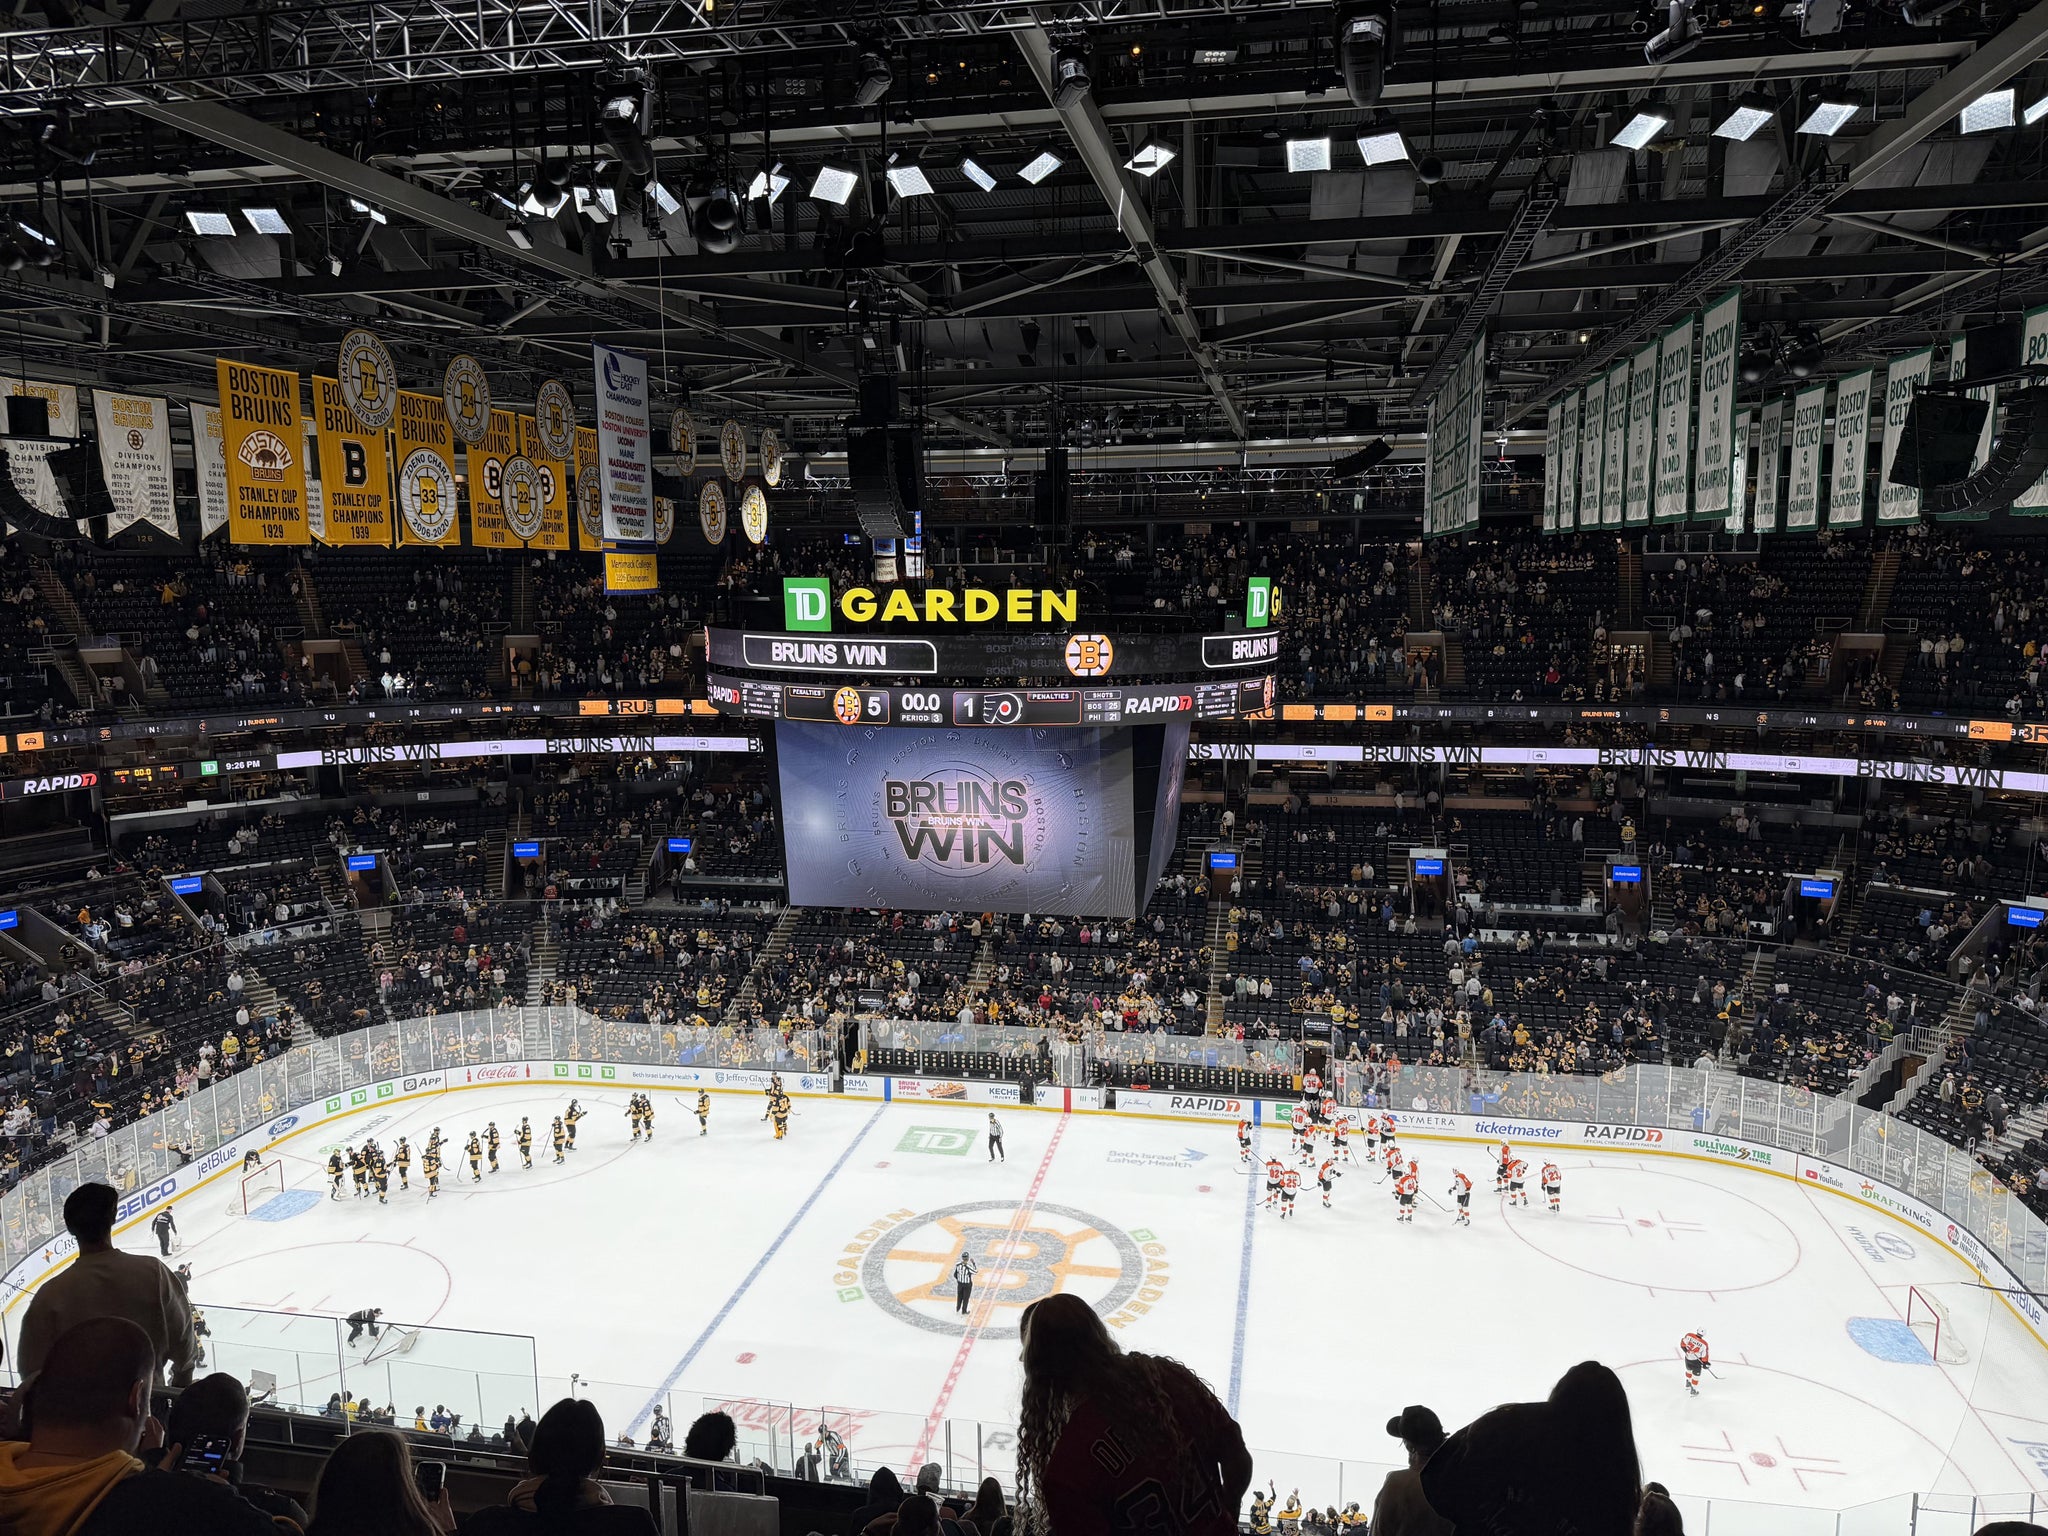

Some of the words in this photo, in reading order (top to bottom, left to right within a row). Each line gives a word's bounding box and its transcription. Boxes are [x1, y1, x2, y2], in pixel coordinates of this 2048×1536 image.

[1704, 320, 1734, 362] BOSTON
[343, 336, 362, 383] RAYMOND
[1662, 344, 1689, 380] BOSTON
[362, 372, 376, 390] 77
[620, 373, 640, 386] HOCKEY
[1633, 366, 1654, 396] BOSTON
[1704, 354, 1730, 393] CELTICS
[228, 366, 291, 400] BOSTON
[620, 382, 632, 392] EAST
[1662, 374, 1688, 409] CELTICS
[111, 397, 152, 415] BOSTON
[462, 394, 474, 408] 24
[606, 390, 642, 407] CHAMPIONSHIP
[1839, 389, 1867, 416] BOSTON
[230, 394, 292, 426] BRUINS
[352, 402, 390, 425] 1979-2000
[400, 395, 445, 422] BOSTON
[1796, 404, 1822, 428] BOSTON
[113, 412, 154, 430] BRUINS
[552, 410, 561, 429] 16
[604, 410, 624, 424] BOSTON
[626, 414, 645, 426] COLLEGE
[1838, 412, 1864, 440] CELTICS
[402, 418, 446, 445] BRUINS
[602, 420, 622, 433] BOSTON
[622, 426, 648, 438] UNIVERSITY
[1795, 426, 1820, 449] CELTICS
[240, 433, 291, 466] BOSTON
[617, 436, 635, 448] UCONN
[118, 451, 155, 461] DIVISION
[1704, 444, 1722, 466] WORLD
[114, 461, 162, 472] CHAMPIONS
[254, 468, 282, 480] BRUINS
[404, 454, 426, 480] ZDENO
[428, 455, 450, 482] CHARA
[608, 458, 646, 472] MASSACHUSETTS
[1697, 466, 1728, 492] CHAMPIONS
[239, 486, 279, 504] STANLEY
[281, 489, 298, 504] CUP
[422, 488, 436, 504] 33
[518, 491, 529, 504] 22
[610, 492, 621, 502] NEW
[1796, 482, 1812, 496] WORLD
[1882, 486, 1918, 504] CHAMPIONS
[332, 492, 366, 508] STANLEY
[368, 494, 382, 508] CUP
[590, 494, 598, 510] 15
[656, 500, 662, 518] 8
[1789, 497, 1815, 512] CHAMPIONS
[240, 504, 300, 521] CHAMPIONS
[333, 510, 384, 524] CHAMPIONS
[611, 504, 646, 516] NORTHEASTERN
[412, 518, 450, 538] 2006-2020
[616, 516, 644, 528] PROVIDENCE
[262, 524, 284, 539] 1929
[351, 526, 370, 539] 1939
[491, 532, 504, 544] 1970
[543, 534, 555, 546] 1972
[620, 528, 643, 538] VERMONT
[635, 560, 652, 570] College
[788, 588, 826, 621] TD
[841, 588, 1077, 622] GARDEN
[1250, 586, 1268, 618] TD
[771, 642, 837, 664] BRUINS
[843, 644, 887, 666] WIN
[1232, 639, 1268, 660] BRUINS
[792, 688, 822, 696] PENALTIES
[867, 696, 882, 716] 5
[902, 693, 940, 712] 00.0
[964, 698, 974, 718] 1
[1108, 702, 1118, 710] 25
[1124, 695, 1193, 714] RAPID7
[902, 714, 930, 722] PERIOD
[932, 715, 940, 723] 3
[323, 745, 396, 765] BRUINS
[402, 743, 440, 760] WIN
[546, 738, 614, 754] BRUINS
[620, 736, 654, 752] WIN
[892, 735, 938, 764] BOSTON
[974, 736, 1018, 765] BRUINS
[1220, 744, 1255, 759] WIN
[1362, 746, 1435, 762] BRUINS
[1443, 748, 1482, 763] WIN
[1599, 748, 1676, 767] BRUINS
[1684, 751, 1726, 769] WIN
[225, 760, 245, 771] 9:26
[246, 760, 260, 770] PM
[1856, 760, 1945, 783] BRUINS
[1954, 766, 2004, 788] WIN
[23, 772, 98, 796] RAPID7
[885, 780, 1028, 820] BRUINS
[1324, 796, 1338, 804] 113
[871, 791, 881, 836] BRUINS
[928, 816, 962, 826] BRUINS
[964, 818, 984, 827] WIN
[1034, 798, 1046, 852] BOSTON
[1072, 788, 1089, 867] BOSTON
[893, 820, 1025, 866] WIN
[556, 1066, 568, 1075] TD
[579, 1066, 591, 1076] TD
[602, 1067, 614, 1078] TD
[658, 1073, 674, 1081] Lahey
[725, 1073, 748, 1083] Jeffrey
[352, 1092, 365, 1103] TD
[378, 1086, 392, 1096] TD
[326, 1100, 340, 1111] TD
[1170, 1096, 1241, 1112] RAPID7
[274, 1117, 294, 1134] Ford
[1402, 1114, 1456, 1126] SYMETRA
[1474, 1122, 1562, 1138] ticketmaster
[1584, 1125, 1663, 1142] RAPID7
[1109, 1150, 1139, 1159] Beth
[1142, 1151, 1177, 1160] Israel
[1693, 1138, 1738, 1154] SULLIVAN
[1752, 1150, 1772, 1161] TIRE
[1719, 1150, 1736, 1158] AUTO
[1749, 1156, 1771, 1165] SERVICE
[197, 1146, 237, 1180] jetBlue
[1106, 1156, 1144, 1166] Lahey
[1148, 1158, 1192, 1168] Health
[1818, 1173, 1844, 1188] YouTube
[116, 1178, 176, 1224] GEICO
[1860, 1186, 1932, 1228] DRAFTKINGS
[832, 1208, 916, 1284] GARDEN
[1844, 1226, 1886, 1264] HYUNDAI
[1960, 1234, 1979, 1254] WASTE
[2006, 1278, 2041, 1325] jetBlue
